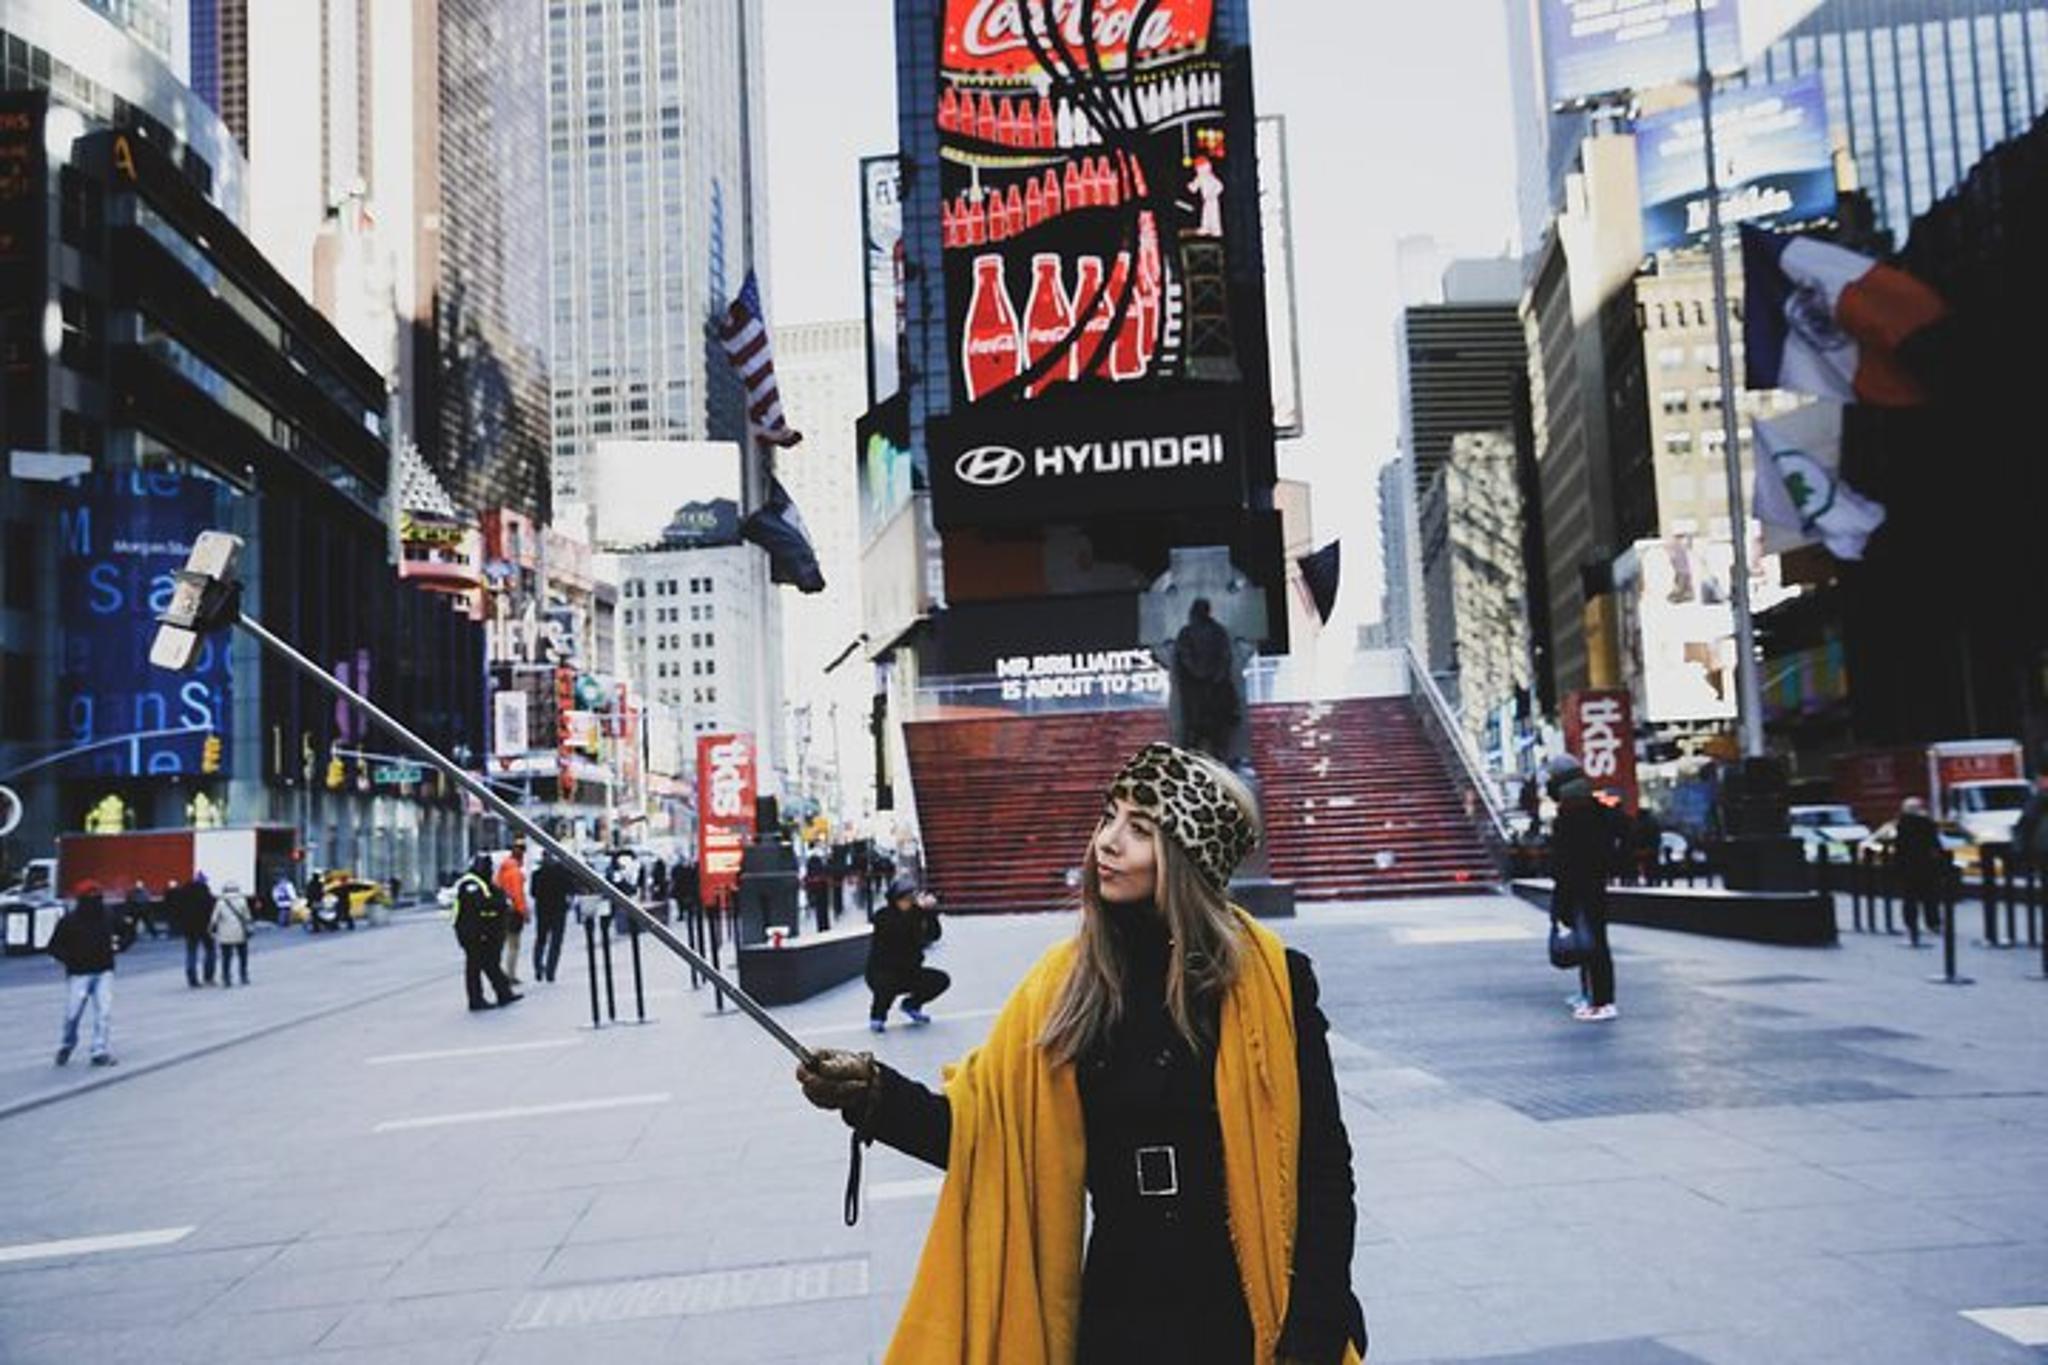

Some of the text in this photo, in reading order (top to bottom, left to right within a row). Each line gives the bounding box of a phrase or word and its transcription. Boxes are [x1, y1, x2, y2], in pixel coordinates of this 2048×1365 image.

[1034, 433, 1223, 477] HYUNDAI
[1025, 674, 1096, 699] ABOUT
[1098, 672, 1127, 695] TO
[1581, 698, 1622, 778] tkts
